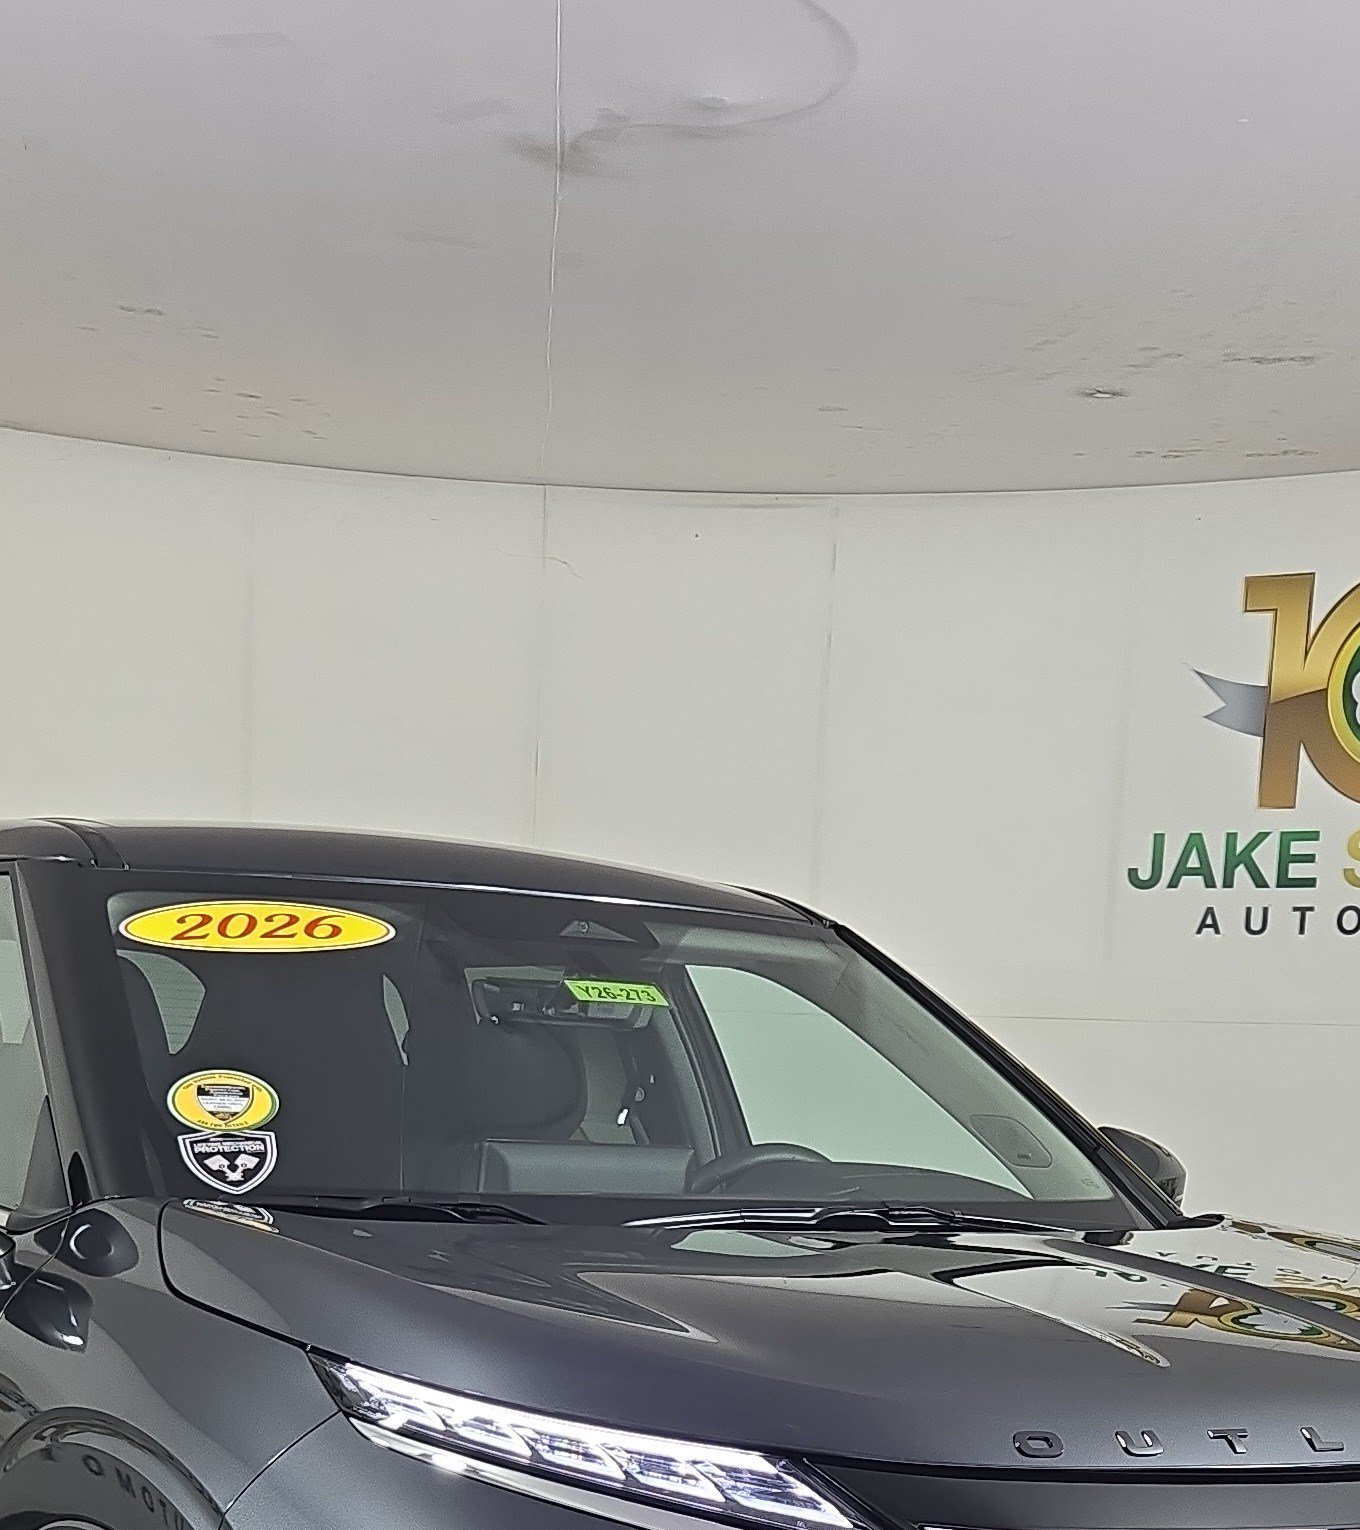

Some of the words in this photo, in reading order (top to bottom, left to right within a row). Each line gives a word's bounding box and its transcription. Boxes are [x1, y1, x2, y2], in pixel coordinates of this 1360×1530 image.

[1127, 830, 1321, 890] JAKE
[170, 913, 346, 940] 2026
[576, 985, 656, 1002] Y26-273
